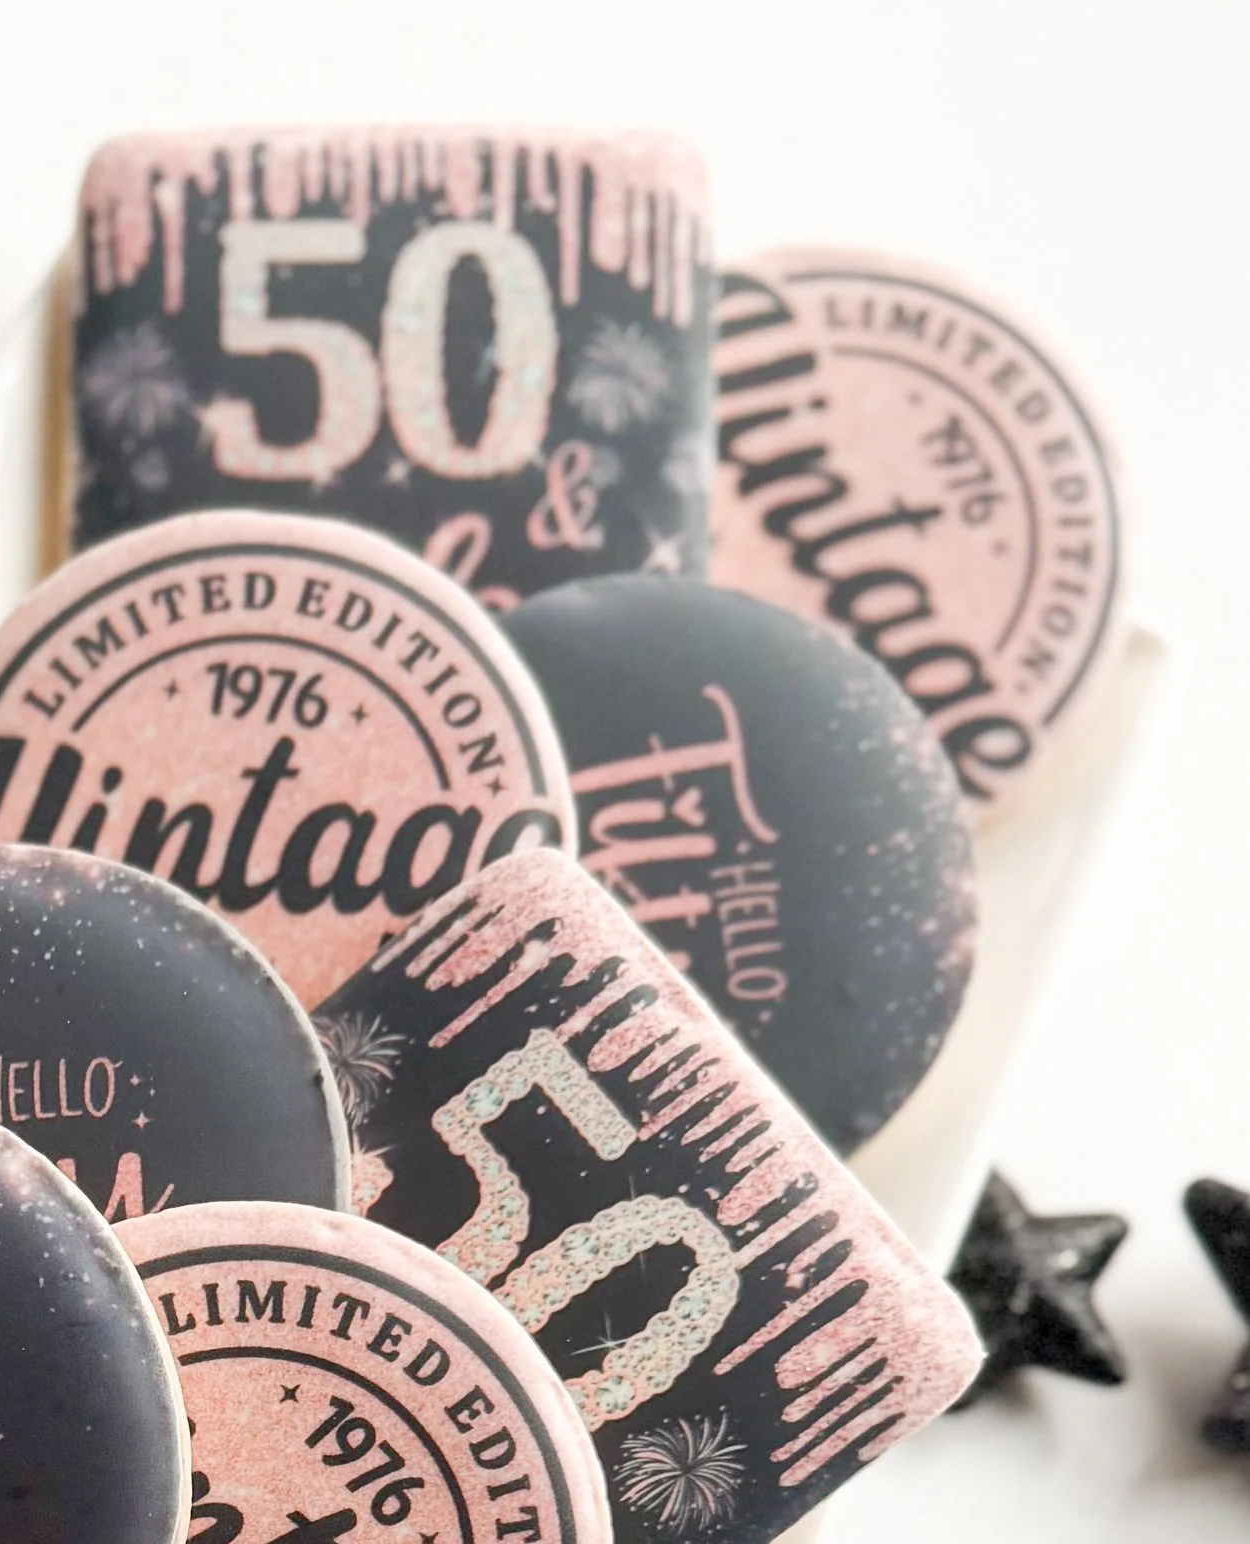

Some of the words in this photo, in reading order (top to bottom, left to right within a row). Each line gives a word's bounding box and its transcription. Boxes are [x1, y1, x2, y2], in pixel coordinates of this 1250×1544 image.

[213, 218, 560, 480] 50
[526, 439, 603, 550] &
[823, 294, 1056, 428] LIMITED
[1016, 438, 1096, 682] EDITION
[22, 571, 278, 723] LIMITED
[295, 579, 508, 776] EDITION
[204, 660, 330, 729] 1976
[710, 860, 787, 1000] HELLO
[159, 1279, 451, 1386] LIMITED
[304, 1397, 426, 1528] 1976
